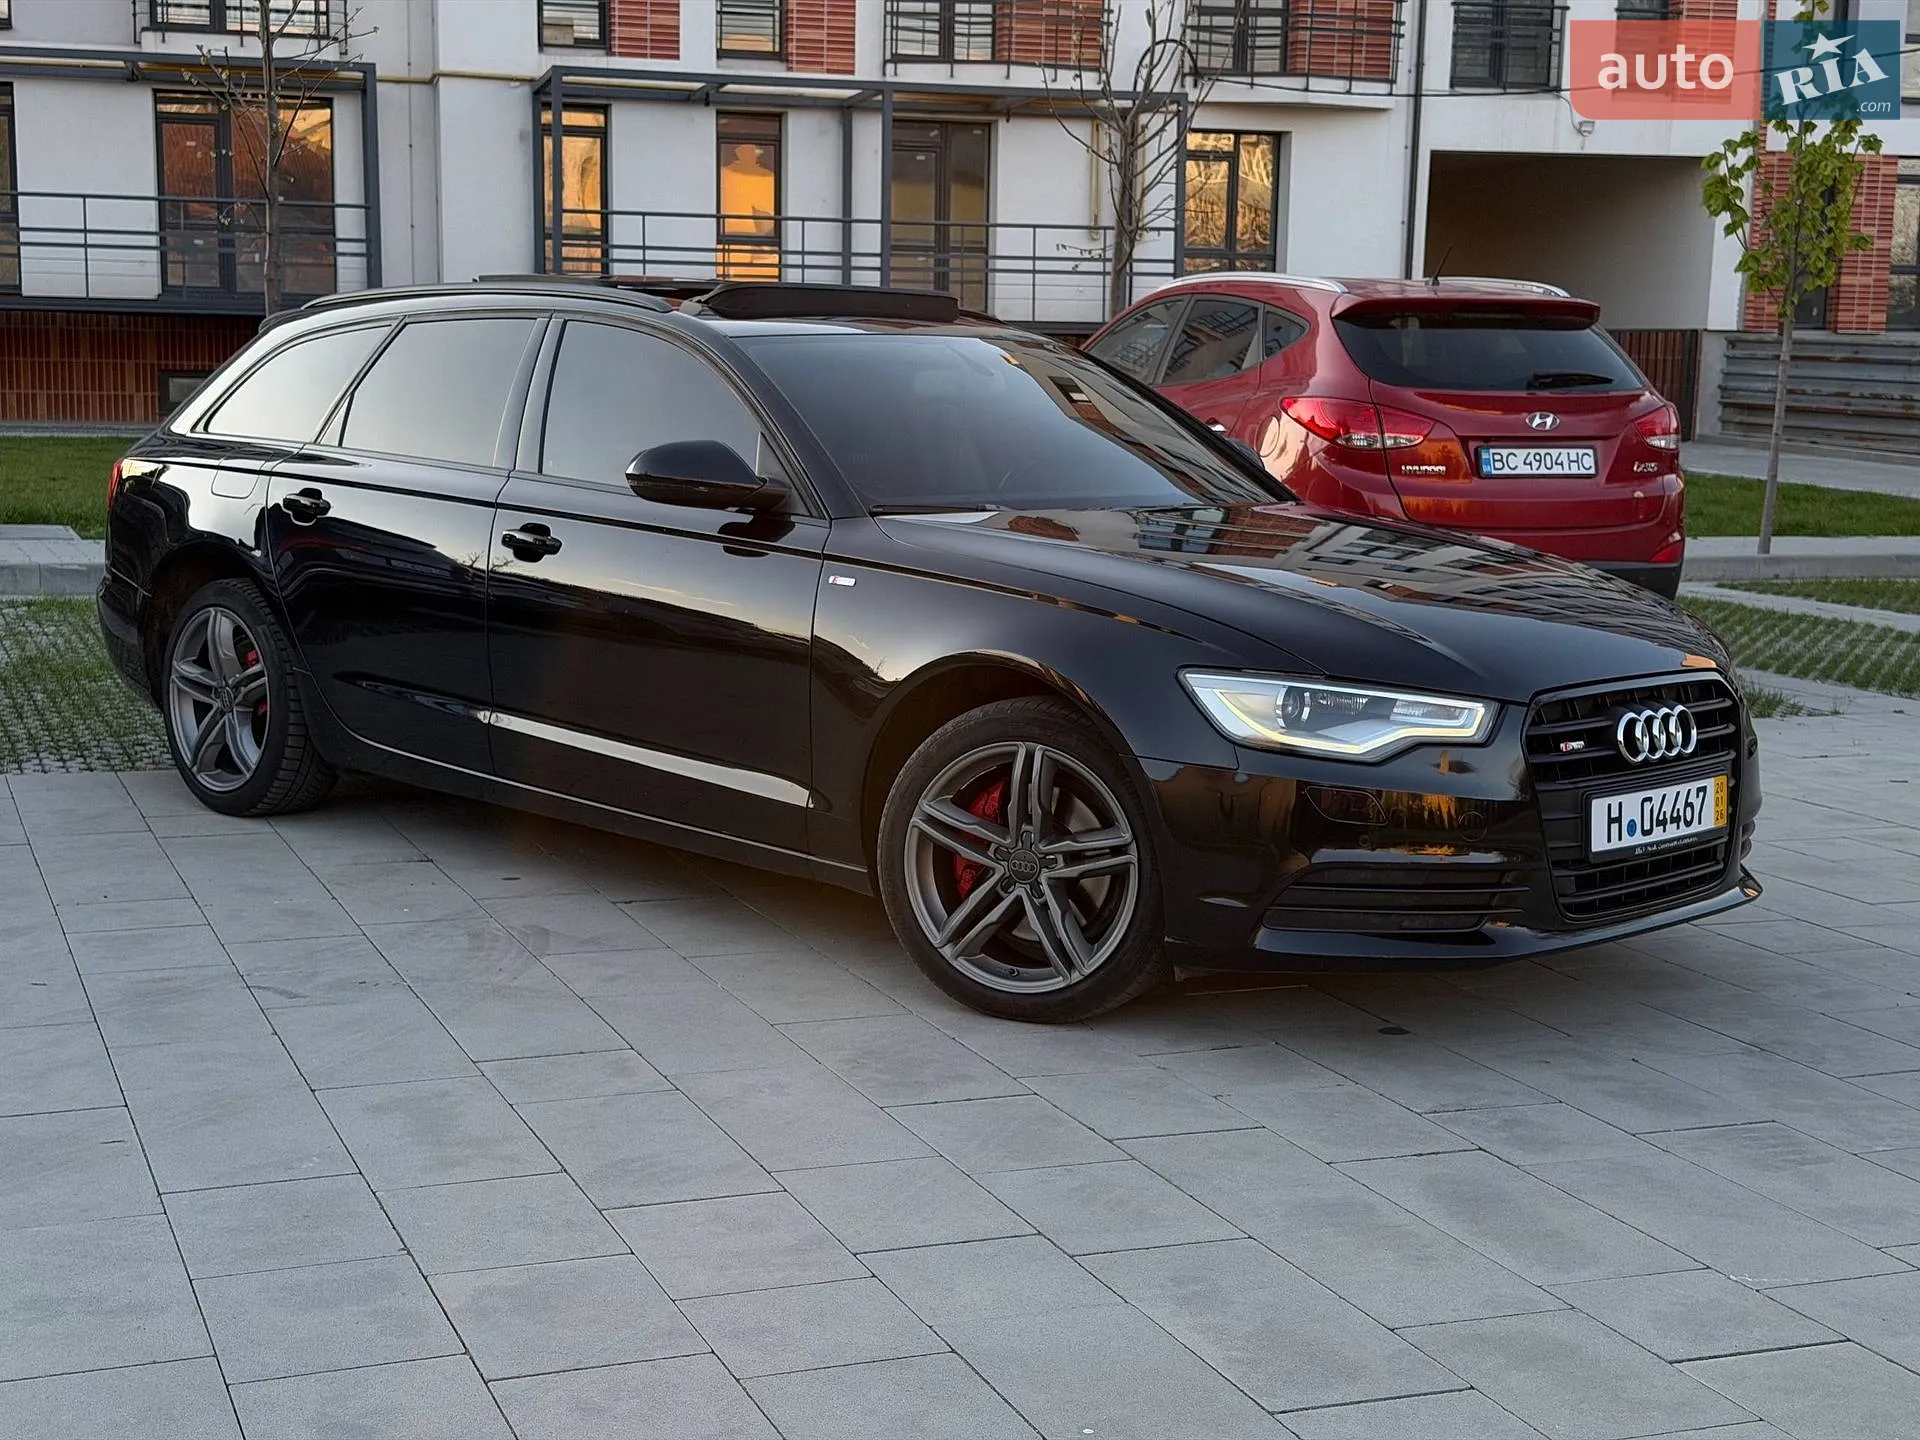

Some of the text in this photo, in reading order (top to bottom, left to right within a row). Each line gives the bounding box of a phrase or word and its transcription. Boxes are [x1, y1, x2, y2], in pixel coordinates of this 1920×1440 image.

[1491, 451, 1593, 471] BC 4904 HC
[1715, 781, 1724, 794] 20
[1607, 785, 1708, 844] H 04467
